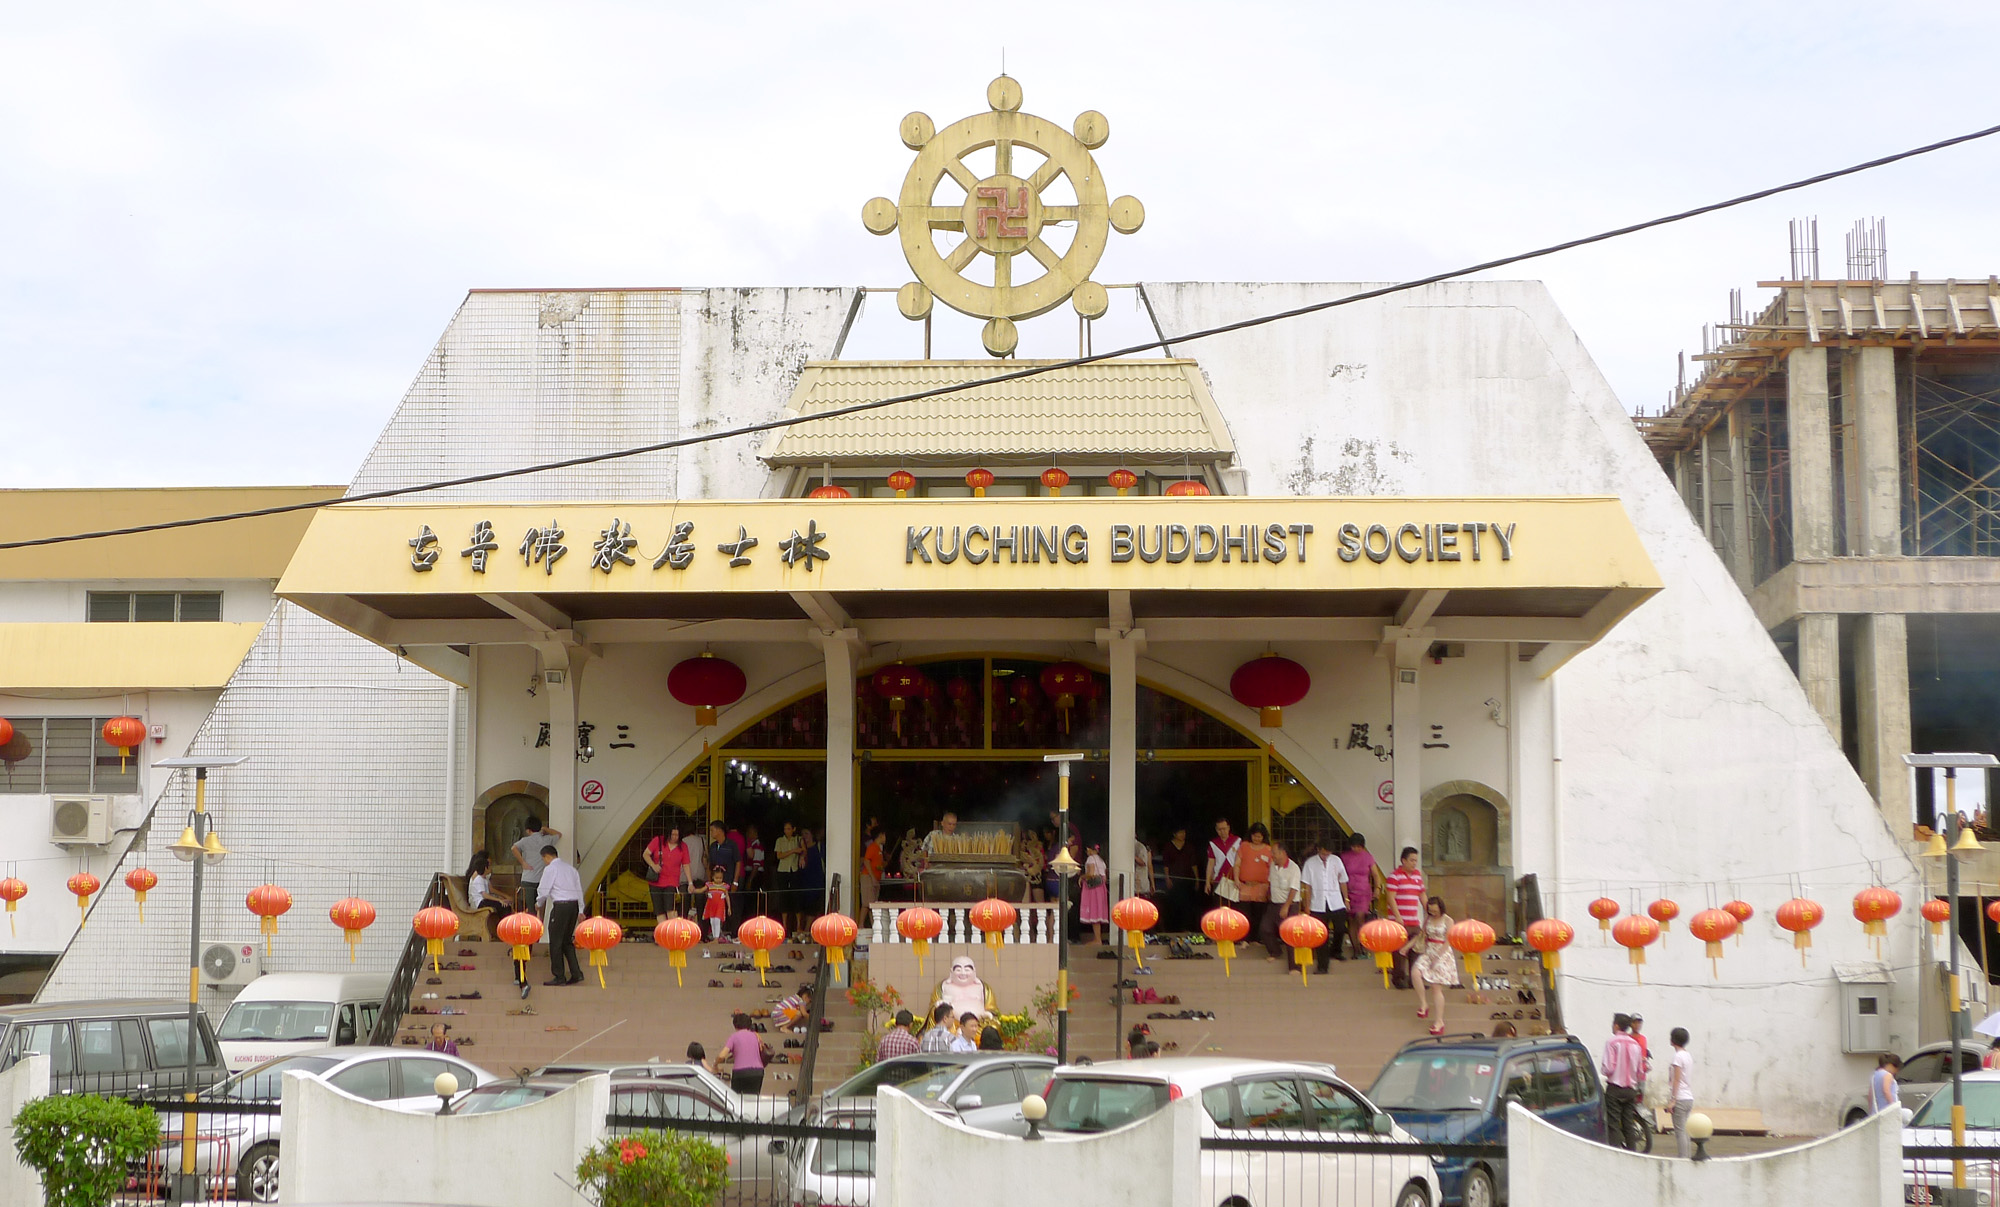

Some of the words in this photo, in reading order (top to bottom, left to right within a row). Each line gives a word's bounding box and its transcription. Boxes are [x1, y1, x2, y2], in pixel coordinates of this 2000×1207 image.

[905, 524, 1089, 564] KUCHING
[1110, 523, 1314, 564] BUDDHIST
[1337, 521, 1517, 564] SOCIETY
[521, 925, 529, 935] 四
[680, 930, 690, 941] 平
